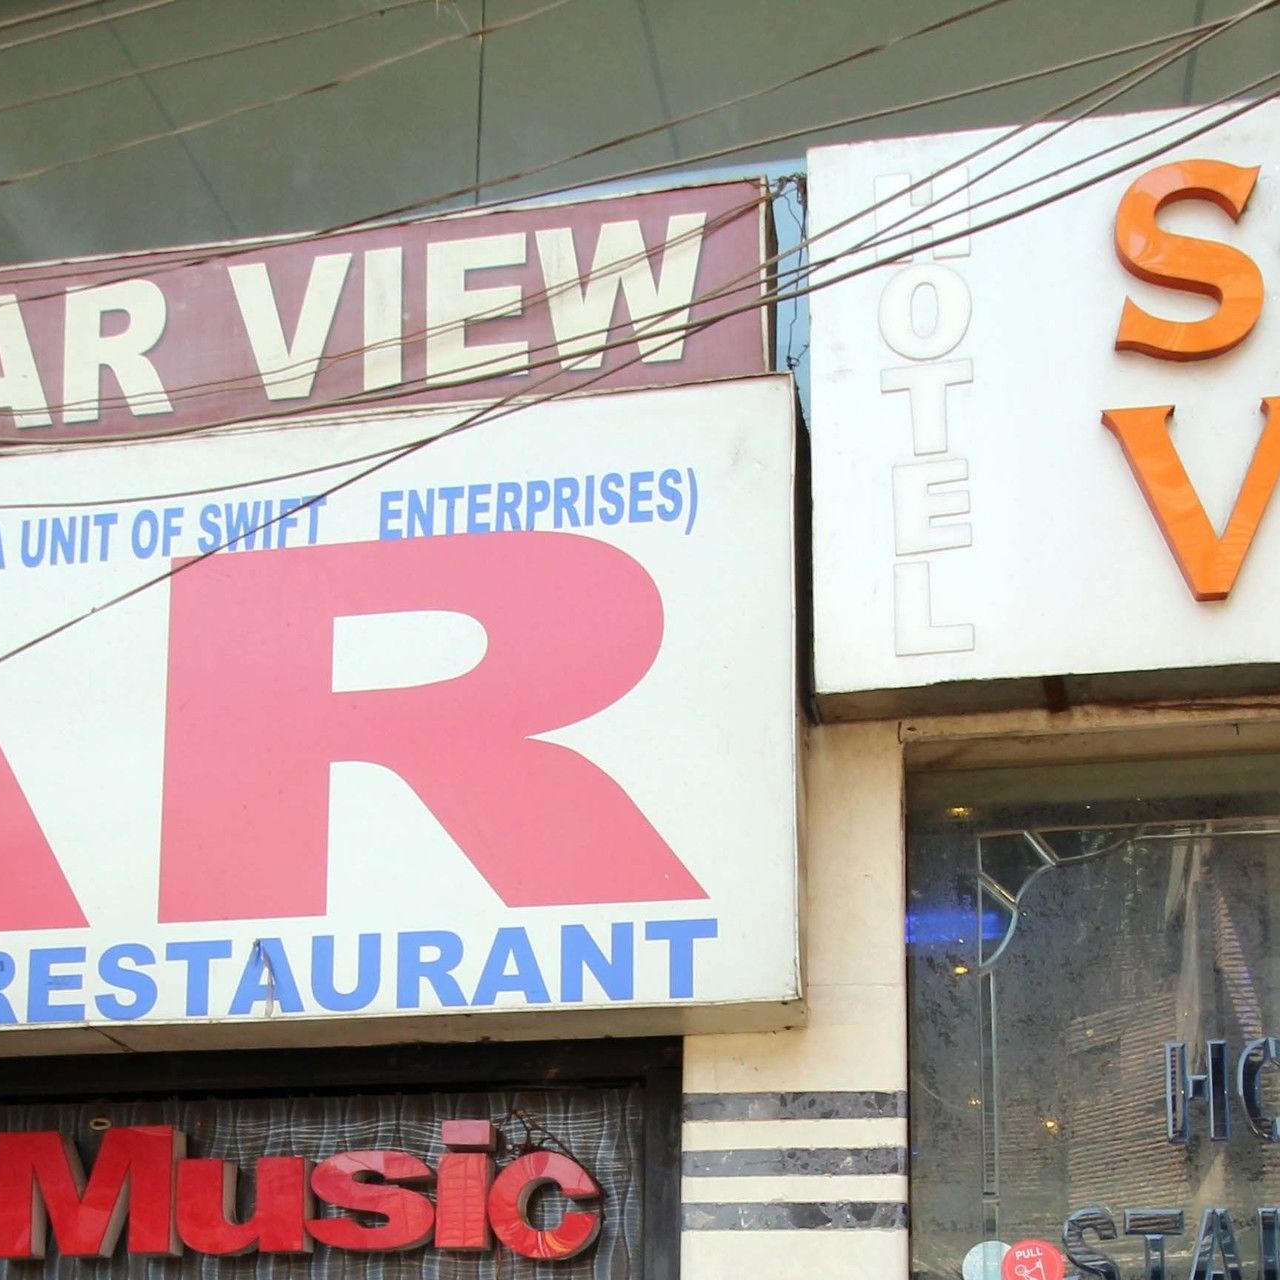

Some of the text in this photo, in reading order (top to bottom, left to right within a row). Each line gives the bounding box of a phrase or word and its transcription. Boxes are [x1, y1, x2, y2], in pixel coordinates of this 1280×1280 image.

[228, 212, 706, 400] VIEW
[873, 165, 975, 657] HOTEL
[20, 512, 115, 569] UNIT
[130, 506, 186, 560] OF
[195, 495, 326, 553] SWIFT
[378, 467, 698, 541] ENTERPRISES)
[1015, 1247, 1043, 1260] PULL
